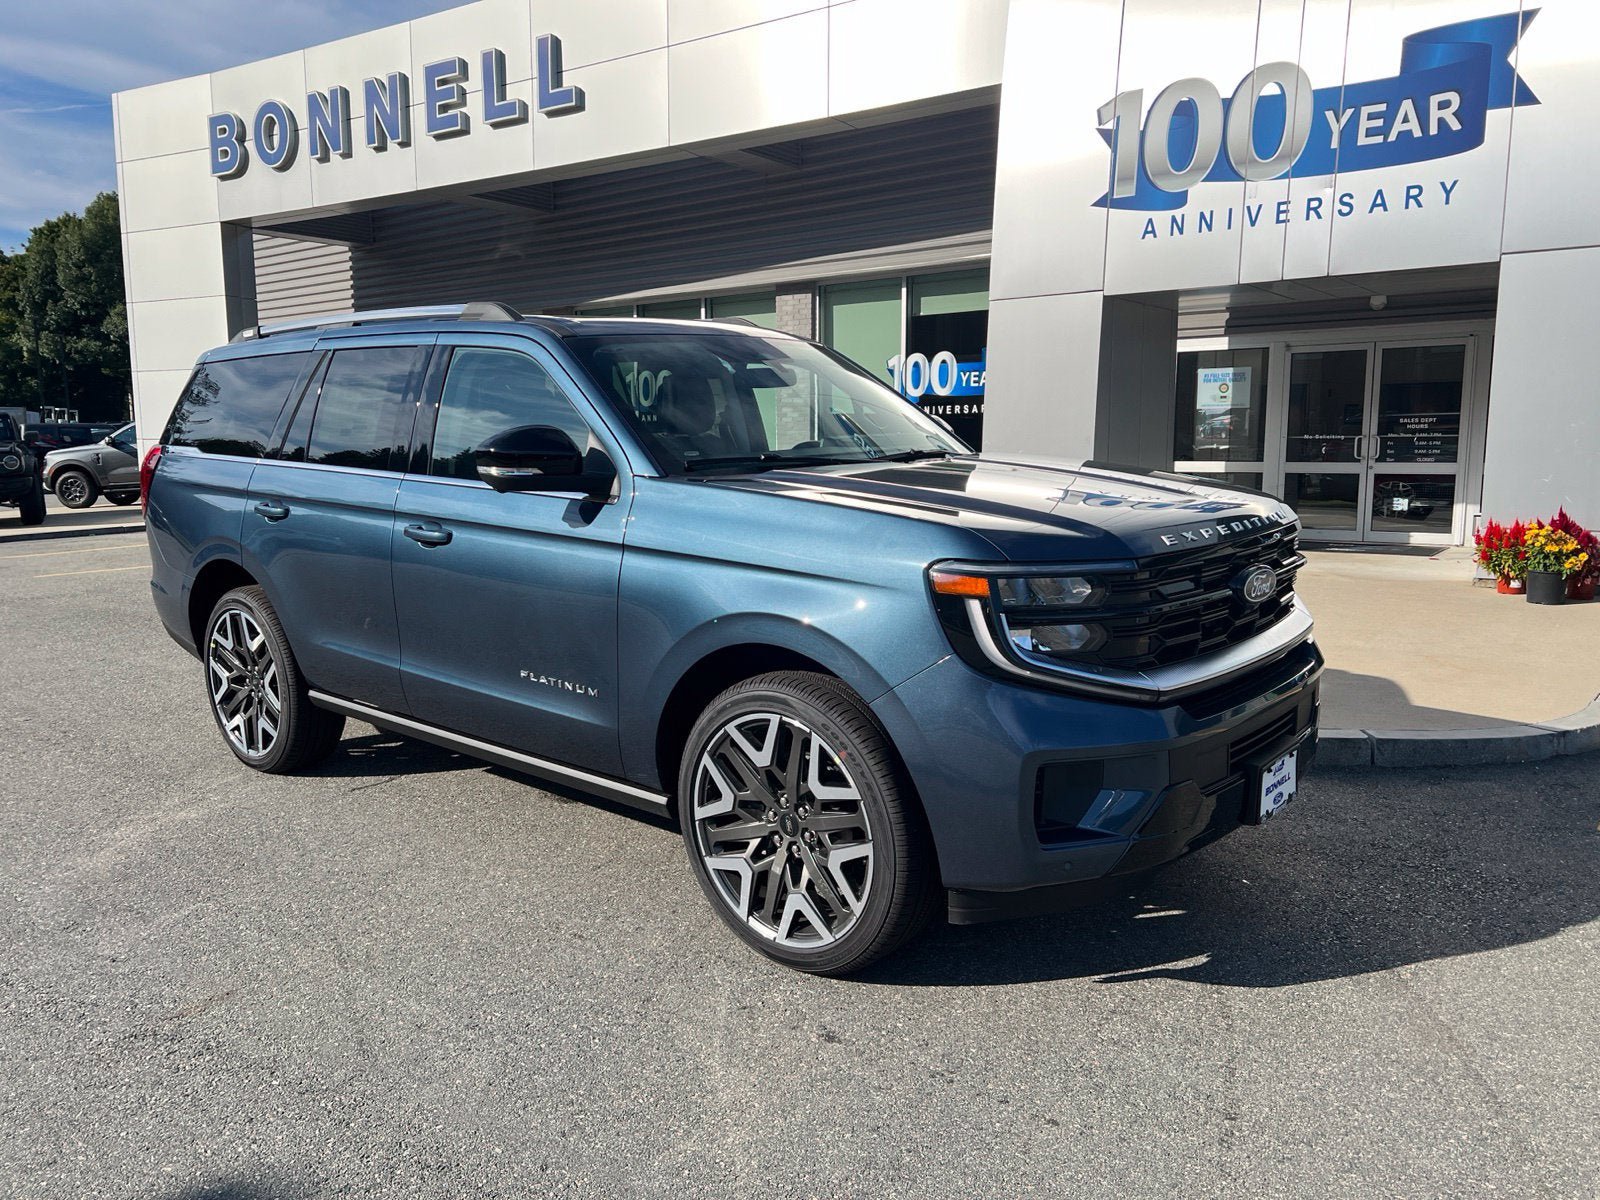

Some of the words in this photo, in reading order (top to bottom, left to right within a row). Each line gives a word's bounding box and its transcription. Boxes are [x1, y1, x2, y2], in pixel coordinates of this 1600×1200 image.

[207, 33, 586, 182] BONNELL
[1096, 61, 1314, 199] 100
[1323, 91, 1463, 149] YEAR
[1141, 179, 1460, 240] ANNIVERSARY
[886, 350, 958, 397] 100
[960, 371, 986, 387] YEA
[1161, 509, 1288, 546] EXPEDITION
[520, 669, 599, 698] PLATINUM
[1265, 772, 1291, 797] BONNELL
